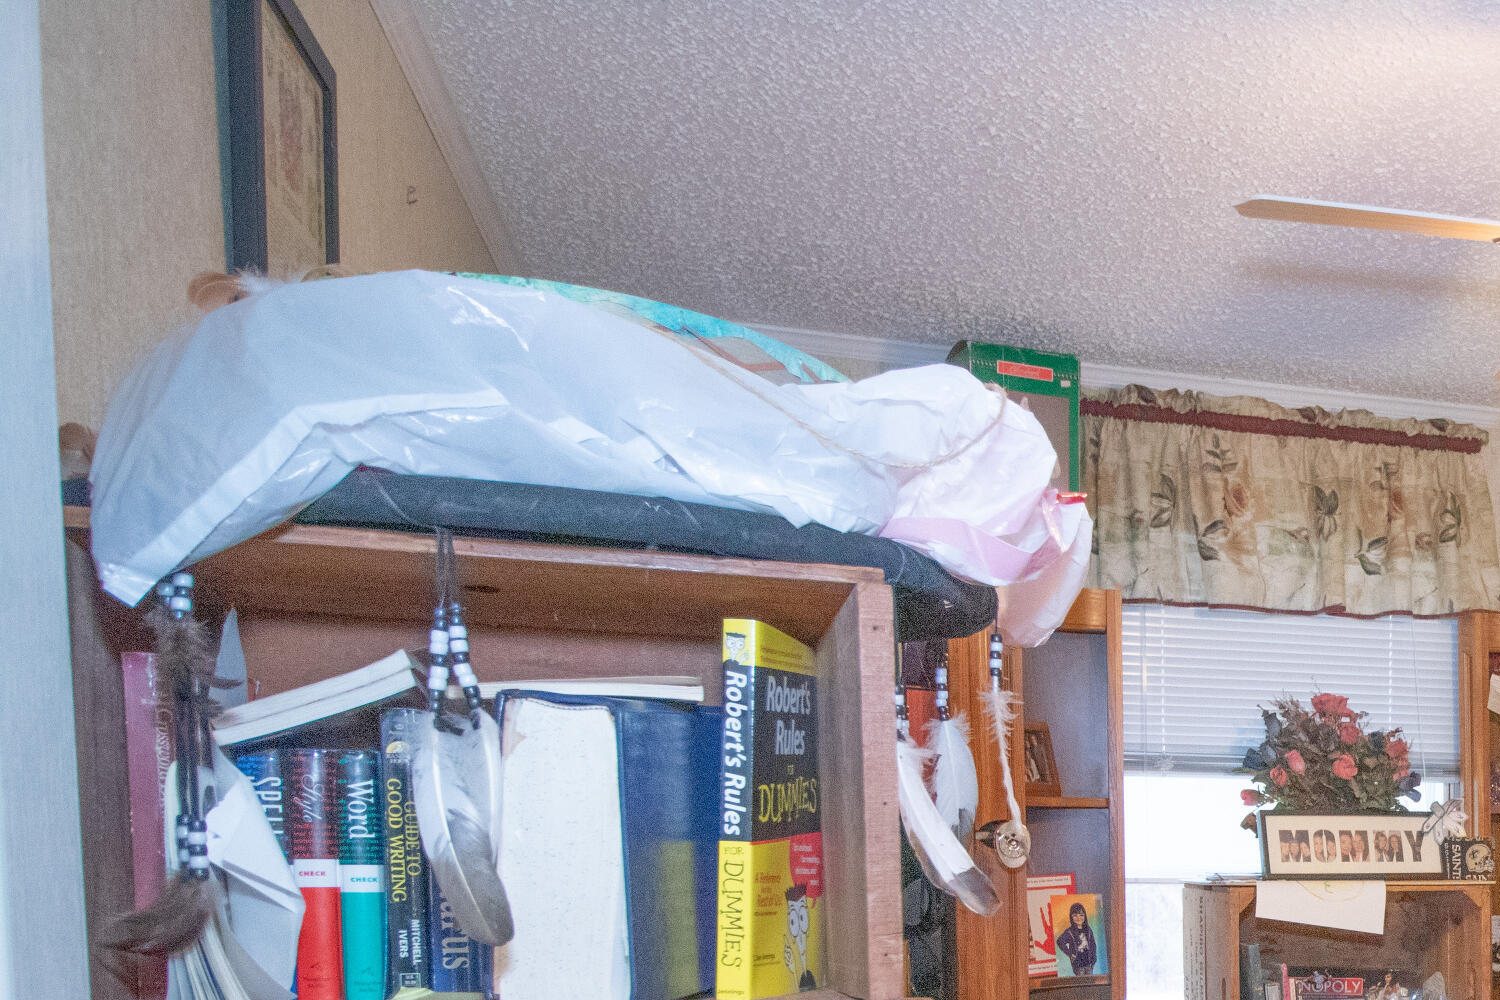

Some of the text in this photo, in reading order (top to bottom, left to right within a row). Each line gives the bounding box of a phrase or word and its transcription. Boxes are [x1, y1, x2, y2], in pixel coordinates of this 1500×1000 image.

[723, 669, 747, 769] Robert's
[765, 675, 811, 715] Robert's
[774, 719, 806, 755] Rules
[293, 774, 324, 823] Style
[347, 778, 374, 840] Word
[723, 774, 746, 836] Rules
[758, 778, 818, 823] DUMMIES
[386, 778, 406, 903] GOOD WRITING
[404, 801, 422, 876] GUIDE TO
[1278, 829, 1425, 864] MOMMY
[721, 862, 745, 970] DUMMIES
[398, 929, 409, 958] IVERS
[410, 919, 422, 965] MITCHELL
